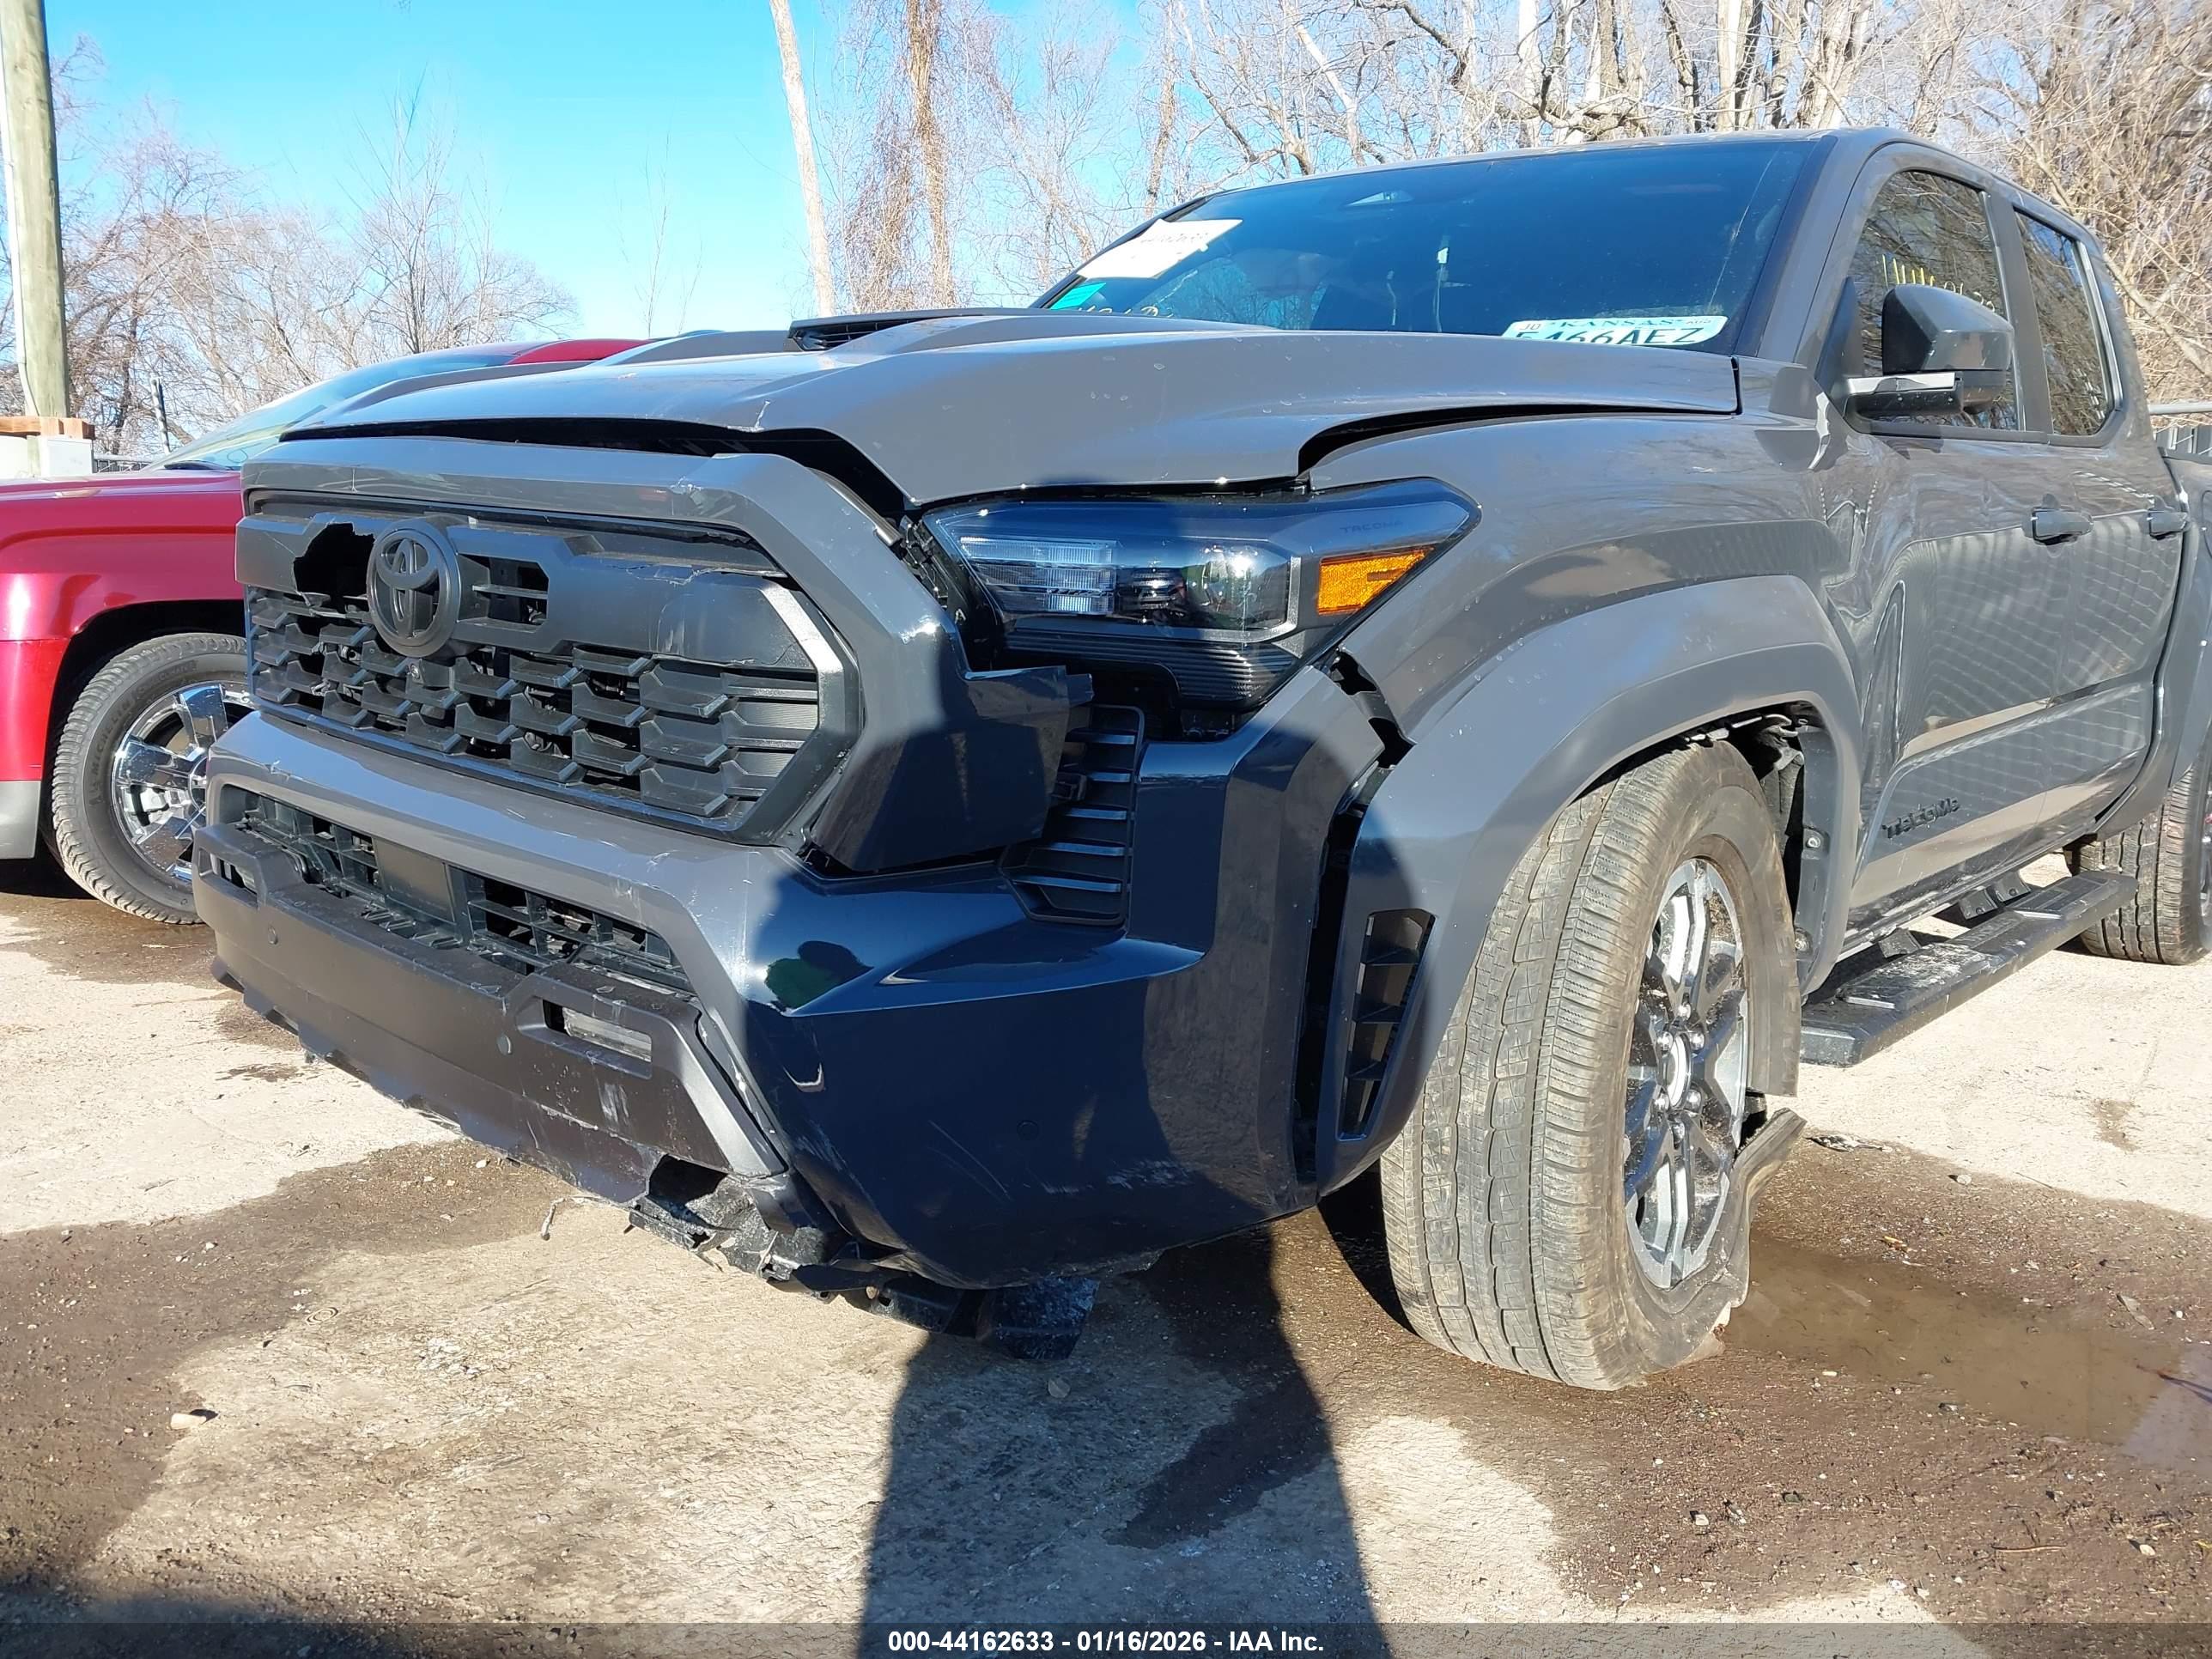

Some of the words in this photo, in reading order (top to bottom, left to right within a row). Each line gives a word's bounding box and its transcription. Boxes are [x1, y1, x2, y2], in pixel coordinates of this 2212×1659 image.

[1558, 318, 1674, 328] KANSAS
[1340, 520, 1403, 533] TACOMA
[90, 697, 133, 775] MICHELIN
[1881, 798, 1960, 839] TACOMA
